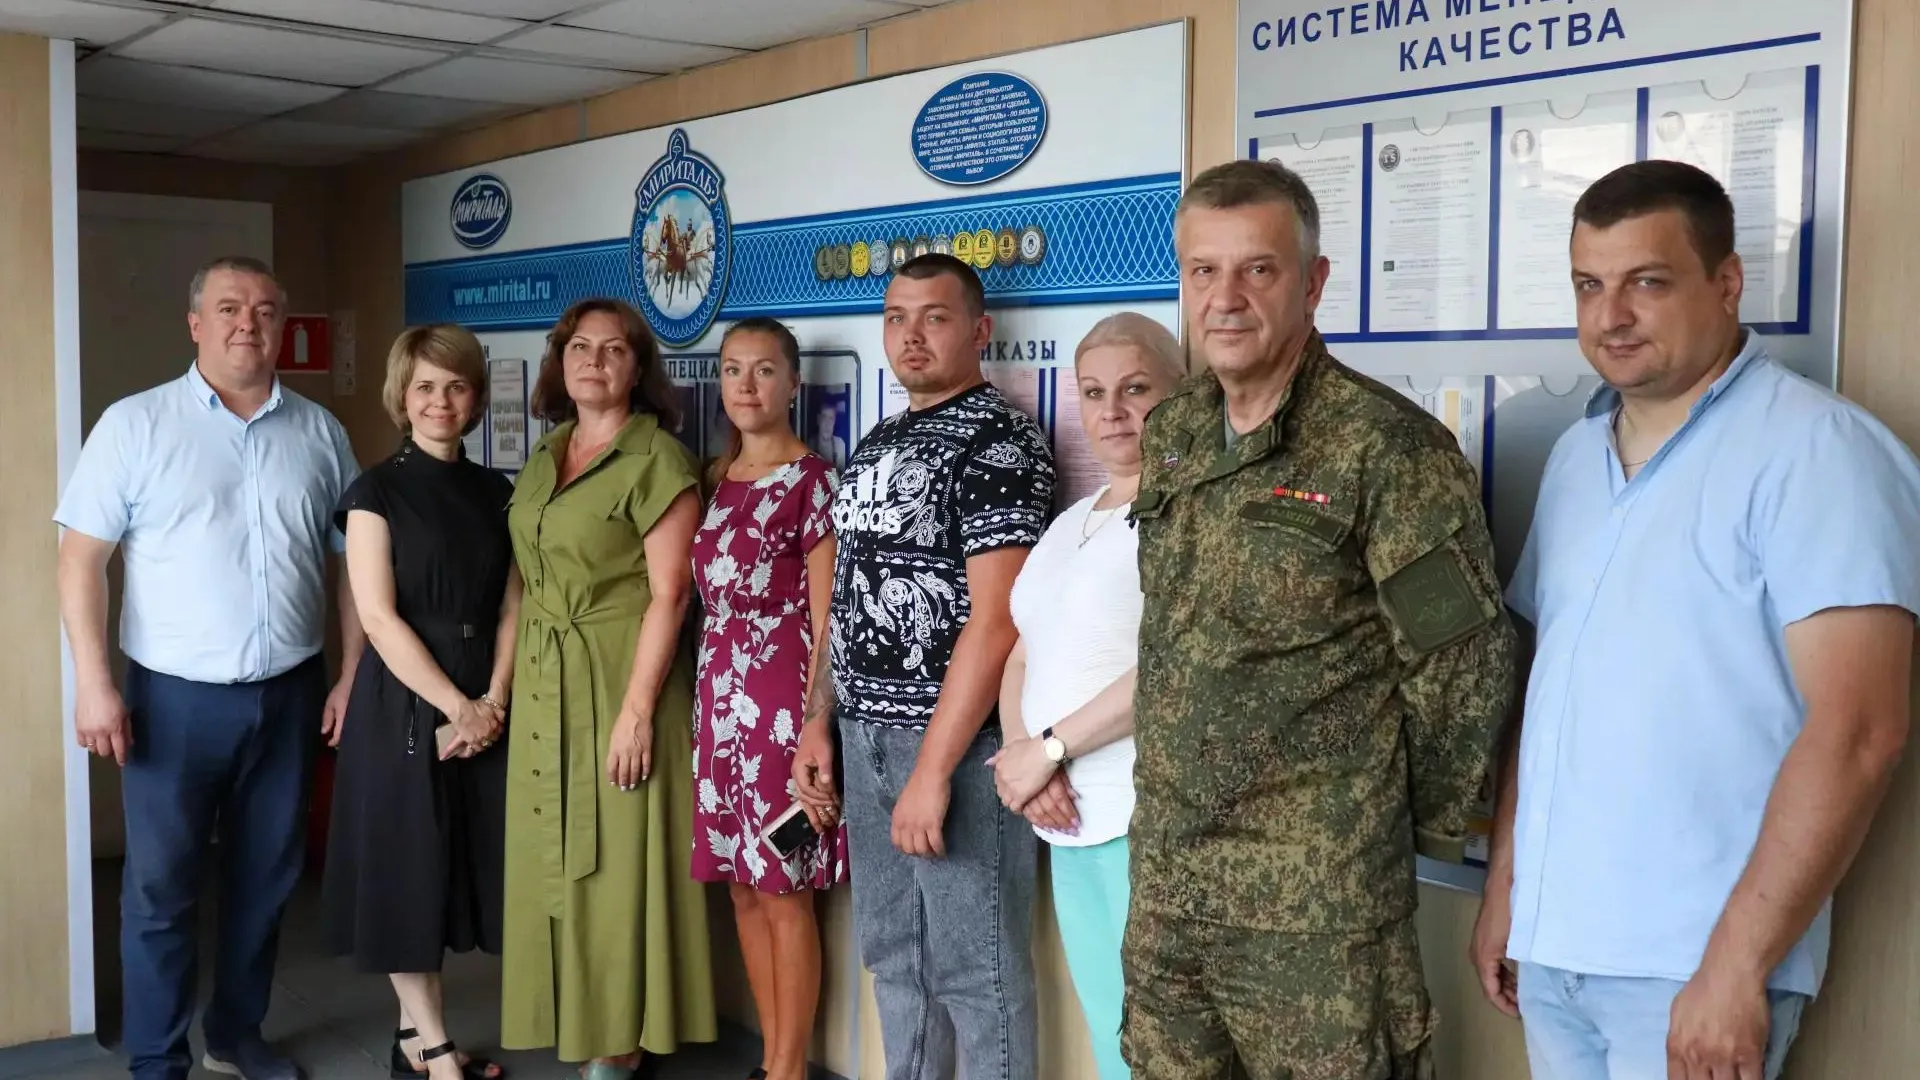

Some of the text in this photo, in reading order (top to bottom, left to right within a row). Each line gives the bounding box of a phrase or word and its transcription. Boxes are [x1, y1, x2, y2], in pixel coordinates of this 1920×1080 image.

[1252, 0, 1429, 51] СИСТЕМА
[1400, 8, 1626, 72] КАЧЕСТВА
[642, 159, 714, 206] МИРИТАЛЬ
[454, 190, 505, 223] МИРИТАЛЬ
[453, 276, 551, 306] www.mirital.ru
[664, 359, 719, 380] ПЕЦИА
